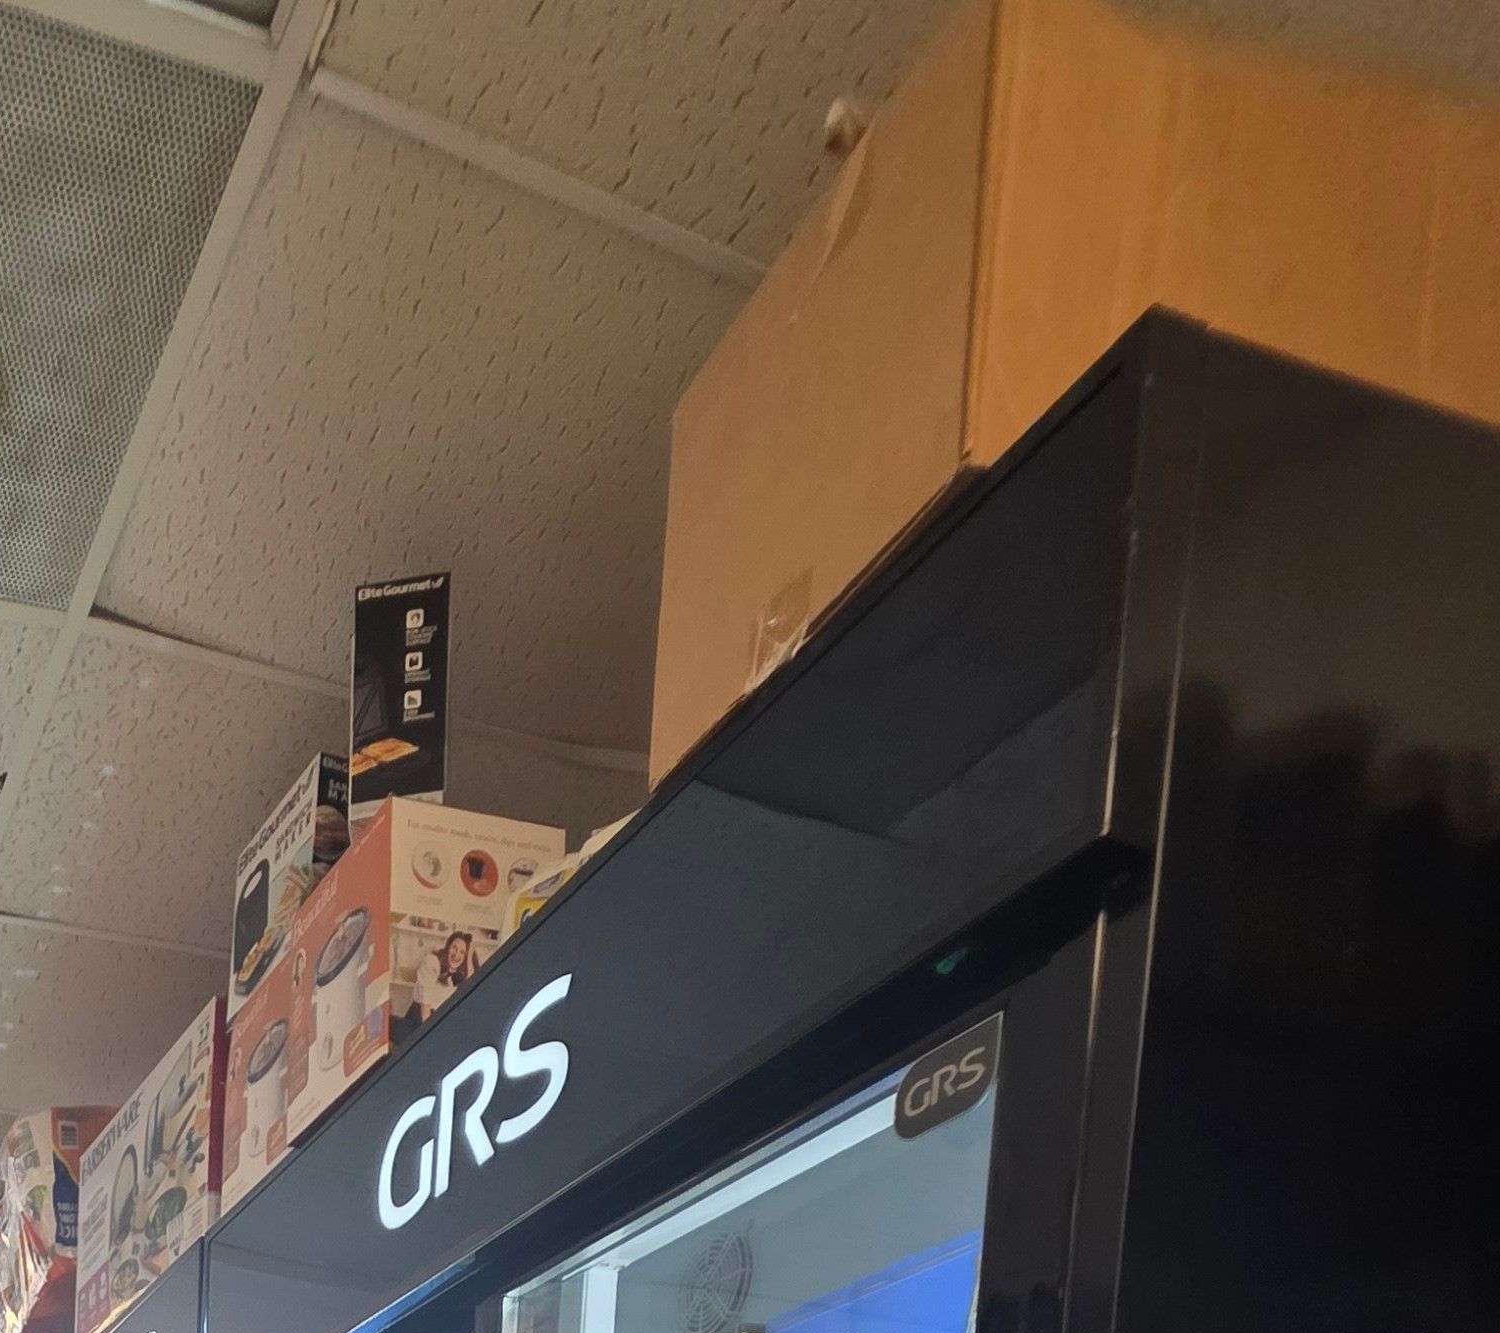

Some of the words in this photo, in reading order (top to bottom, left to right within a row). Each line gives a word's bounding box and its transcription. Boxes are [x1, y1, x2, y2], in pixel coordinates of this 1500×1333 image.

[358, 586, 383, 601] Elite
[383, 578, 431, 597] Gourmet
[378, 973, 573, 1230] GRS
[903, 1046, 986, 1118] GRS
